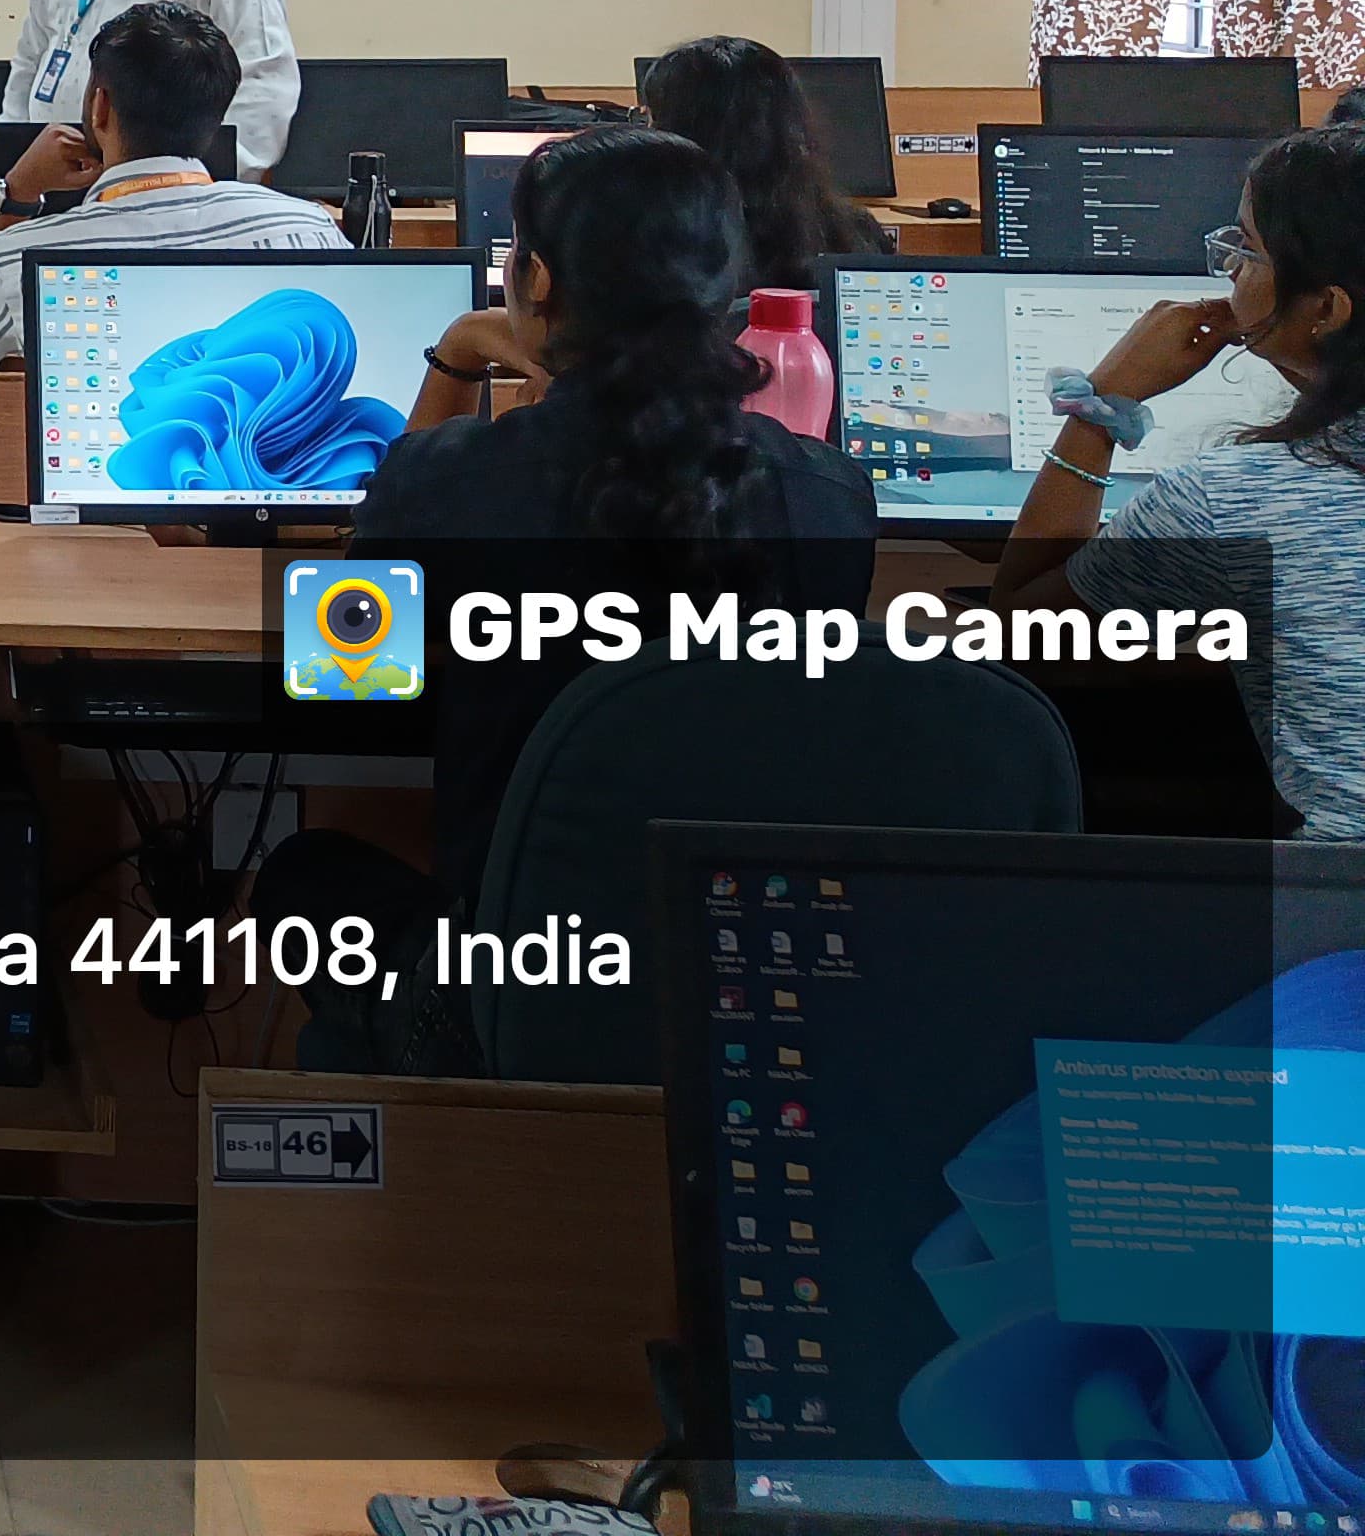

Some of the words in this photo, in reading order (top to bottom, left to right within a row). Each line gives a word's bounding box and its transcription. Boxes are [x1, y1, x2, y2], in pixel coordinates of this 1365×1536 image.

[1054, 1059, 1127, 1078] Antivirus
[1131, 1065, 1220, 1082] protection
[1223, 1068, 1289, 1086] expired
[282, 1130, 327, 1156] 46
